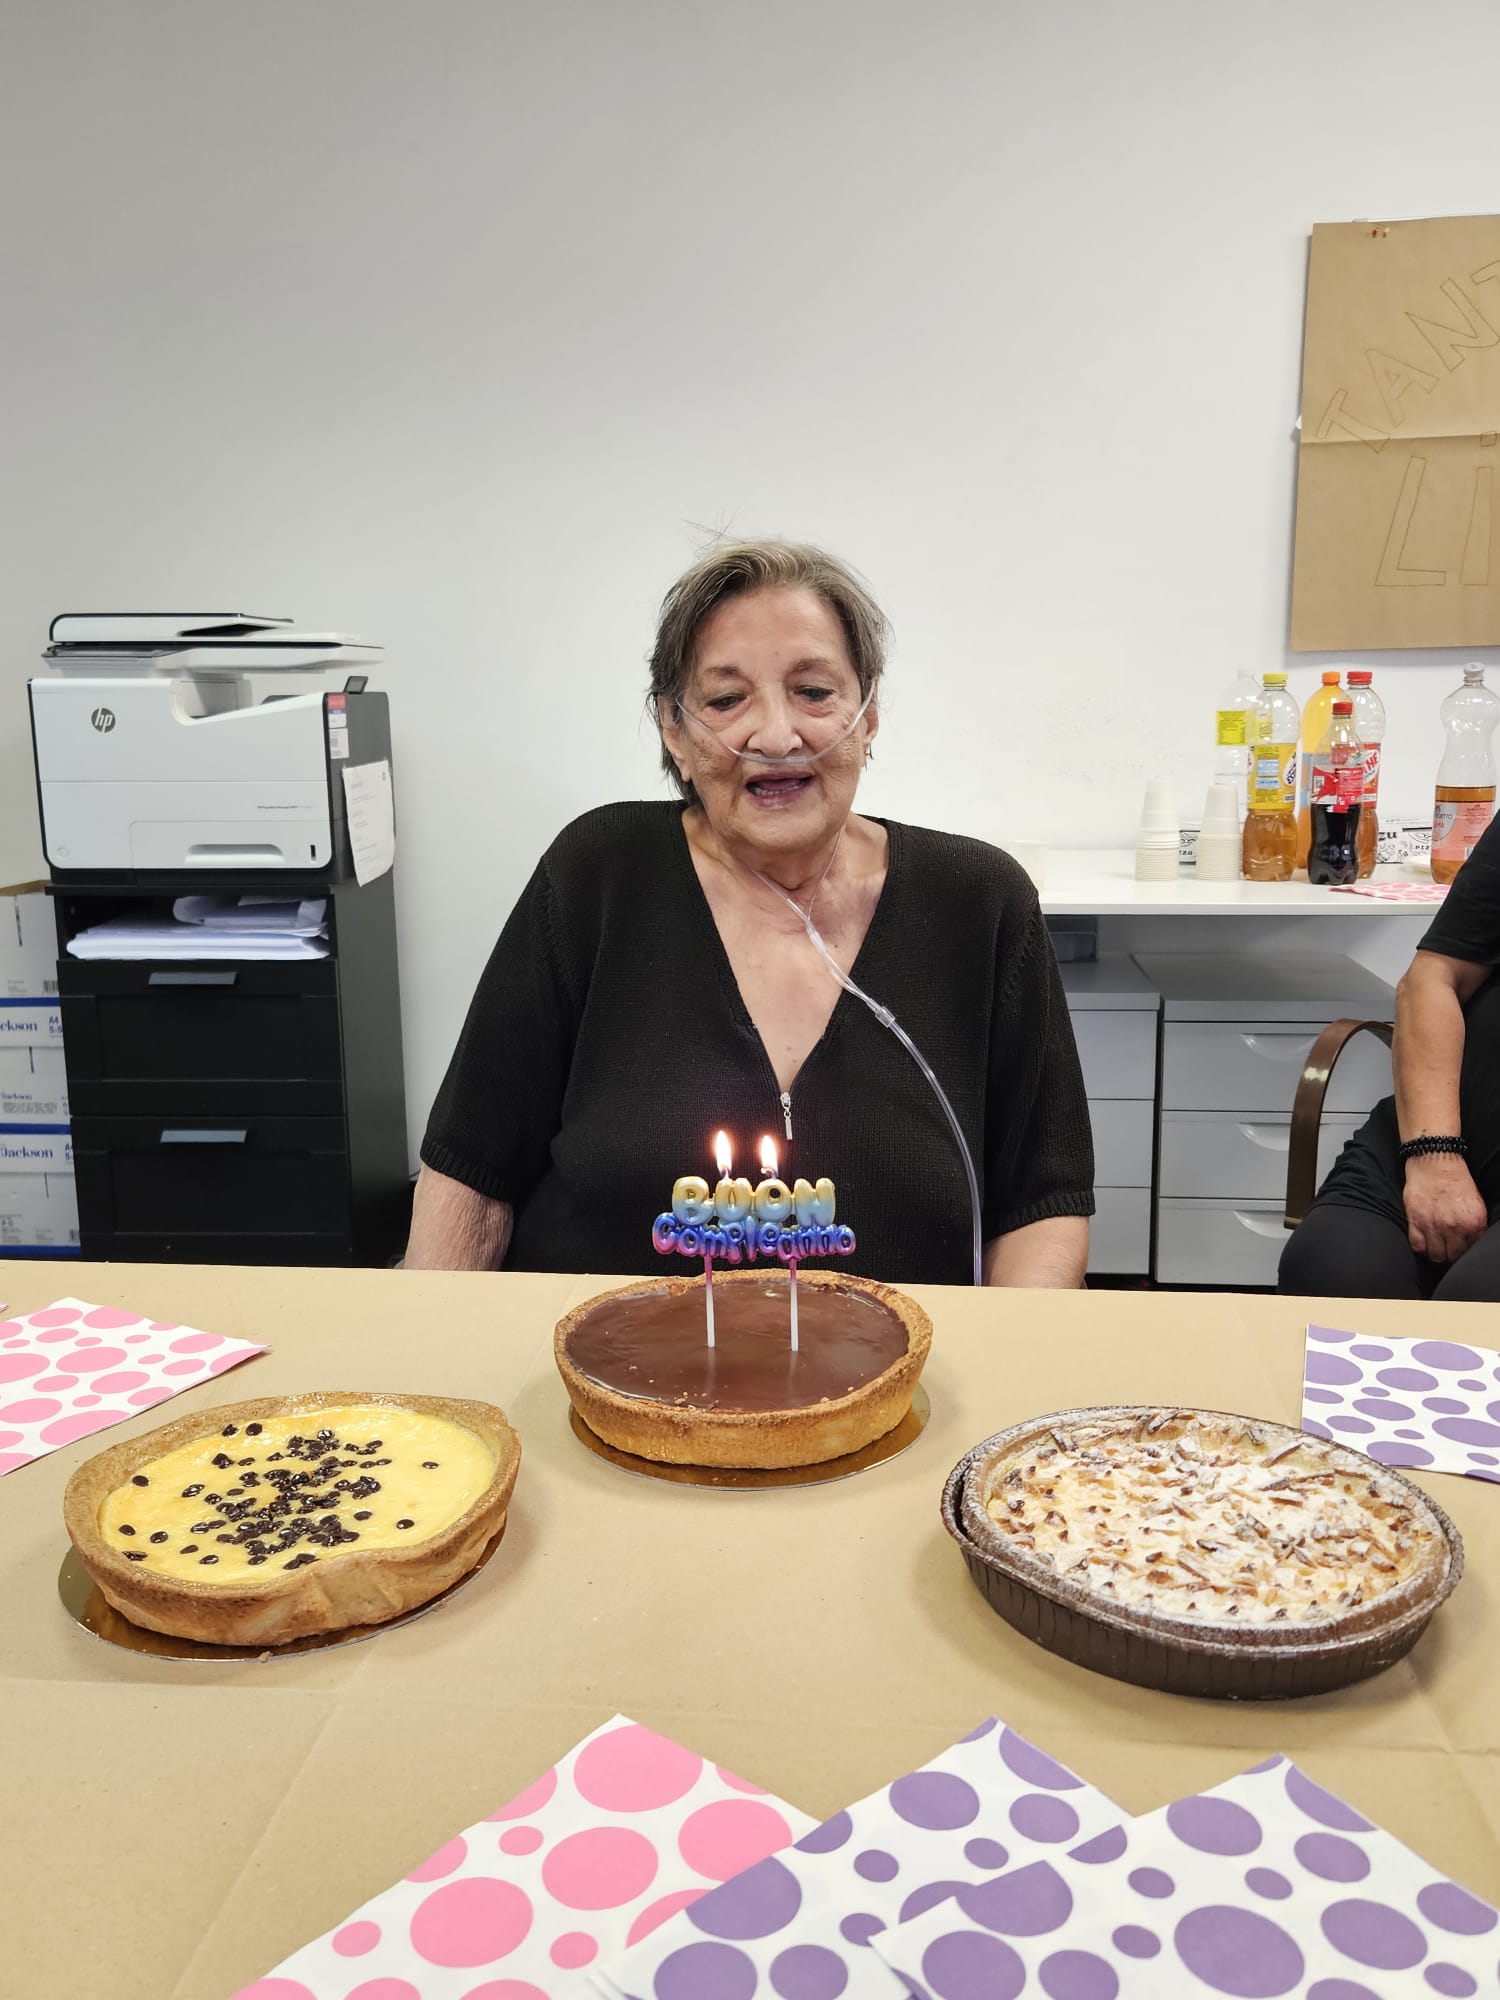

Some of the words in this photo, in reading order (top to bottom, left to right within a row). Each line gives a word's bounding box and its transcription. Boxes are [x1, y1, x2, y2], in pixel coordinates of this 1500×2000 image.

[94, 707, 114, 733] hp
[672, 1175, 837, 1227] BUON
[652, 1212, 857, 1265] Compleanno
